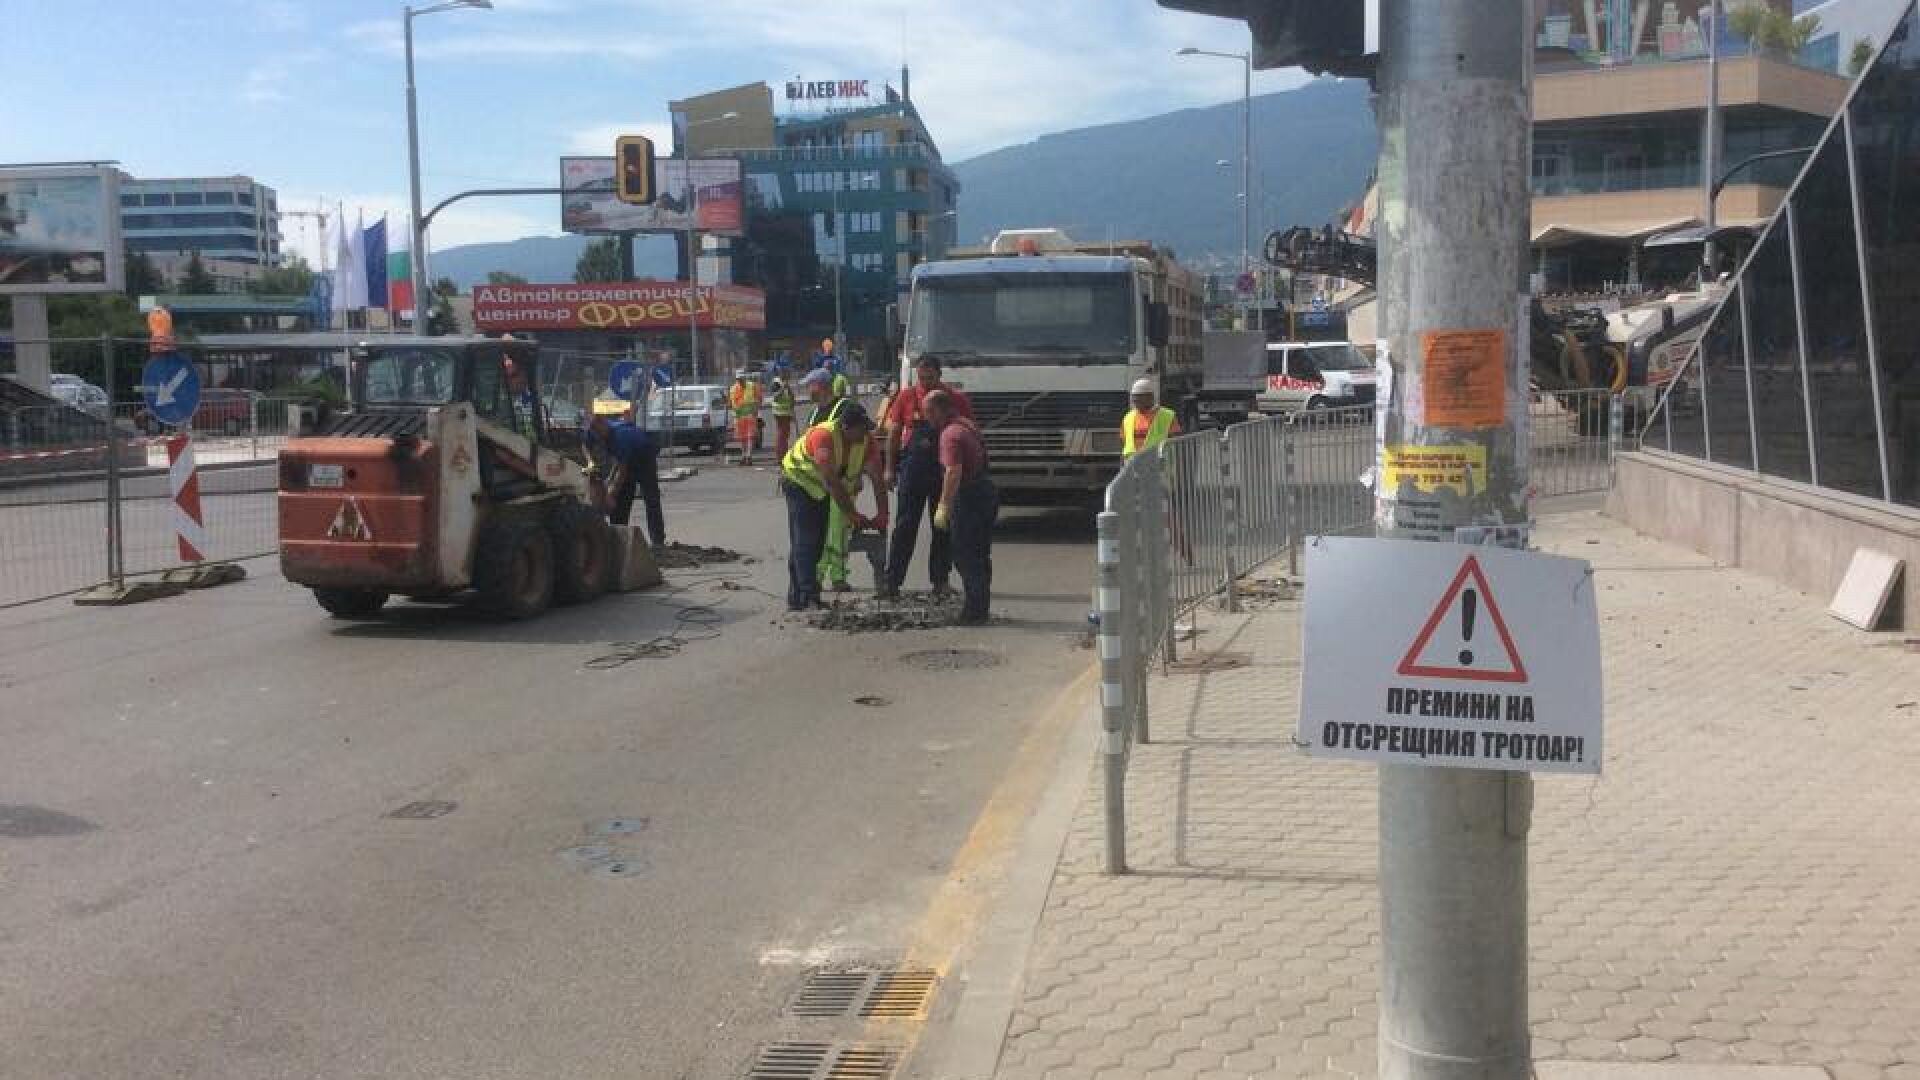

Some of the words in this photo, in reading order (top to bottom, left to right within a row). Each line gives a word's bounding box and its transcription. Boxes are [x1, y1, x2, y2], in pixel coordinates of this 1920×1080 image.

[478, 308, 571, 322] център
[577, 296, 711, 328] Фреш
[1386, 687, 1501, 721] ПРЕМИНИ
[1506, 695, 1536, 723] НА
[1322, 722, 1476, 759] ОТСРЕЩНИЯ
[1482, 732, 1585, 763] ТРОТОАР!
